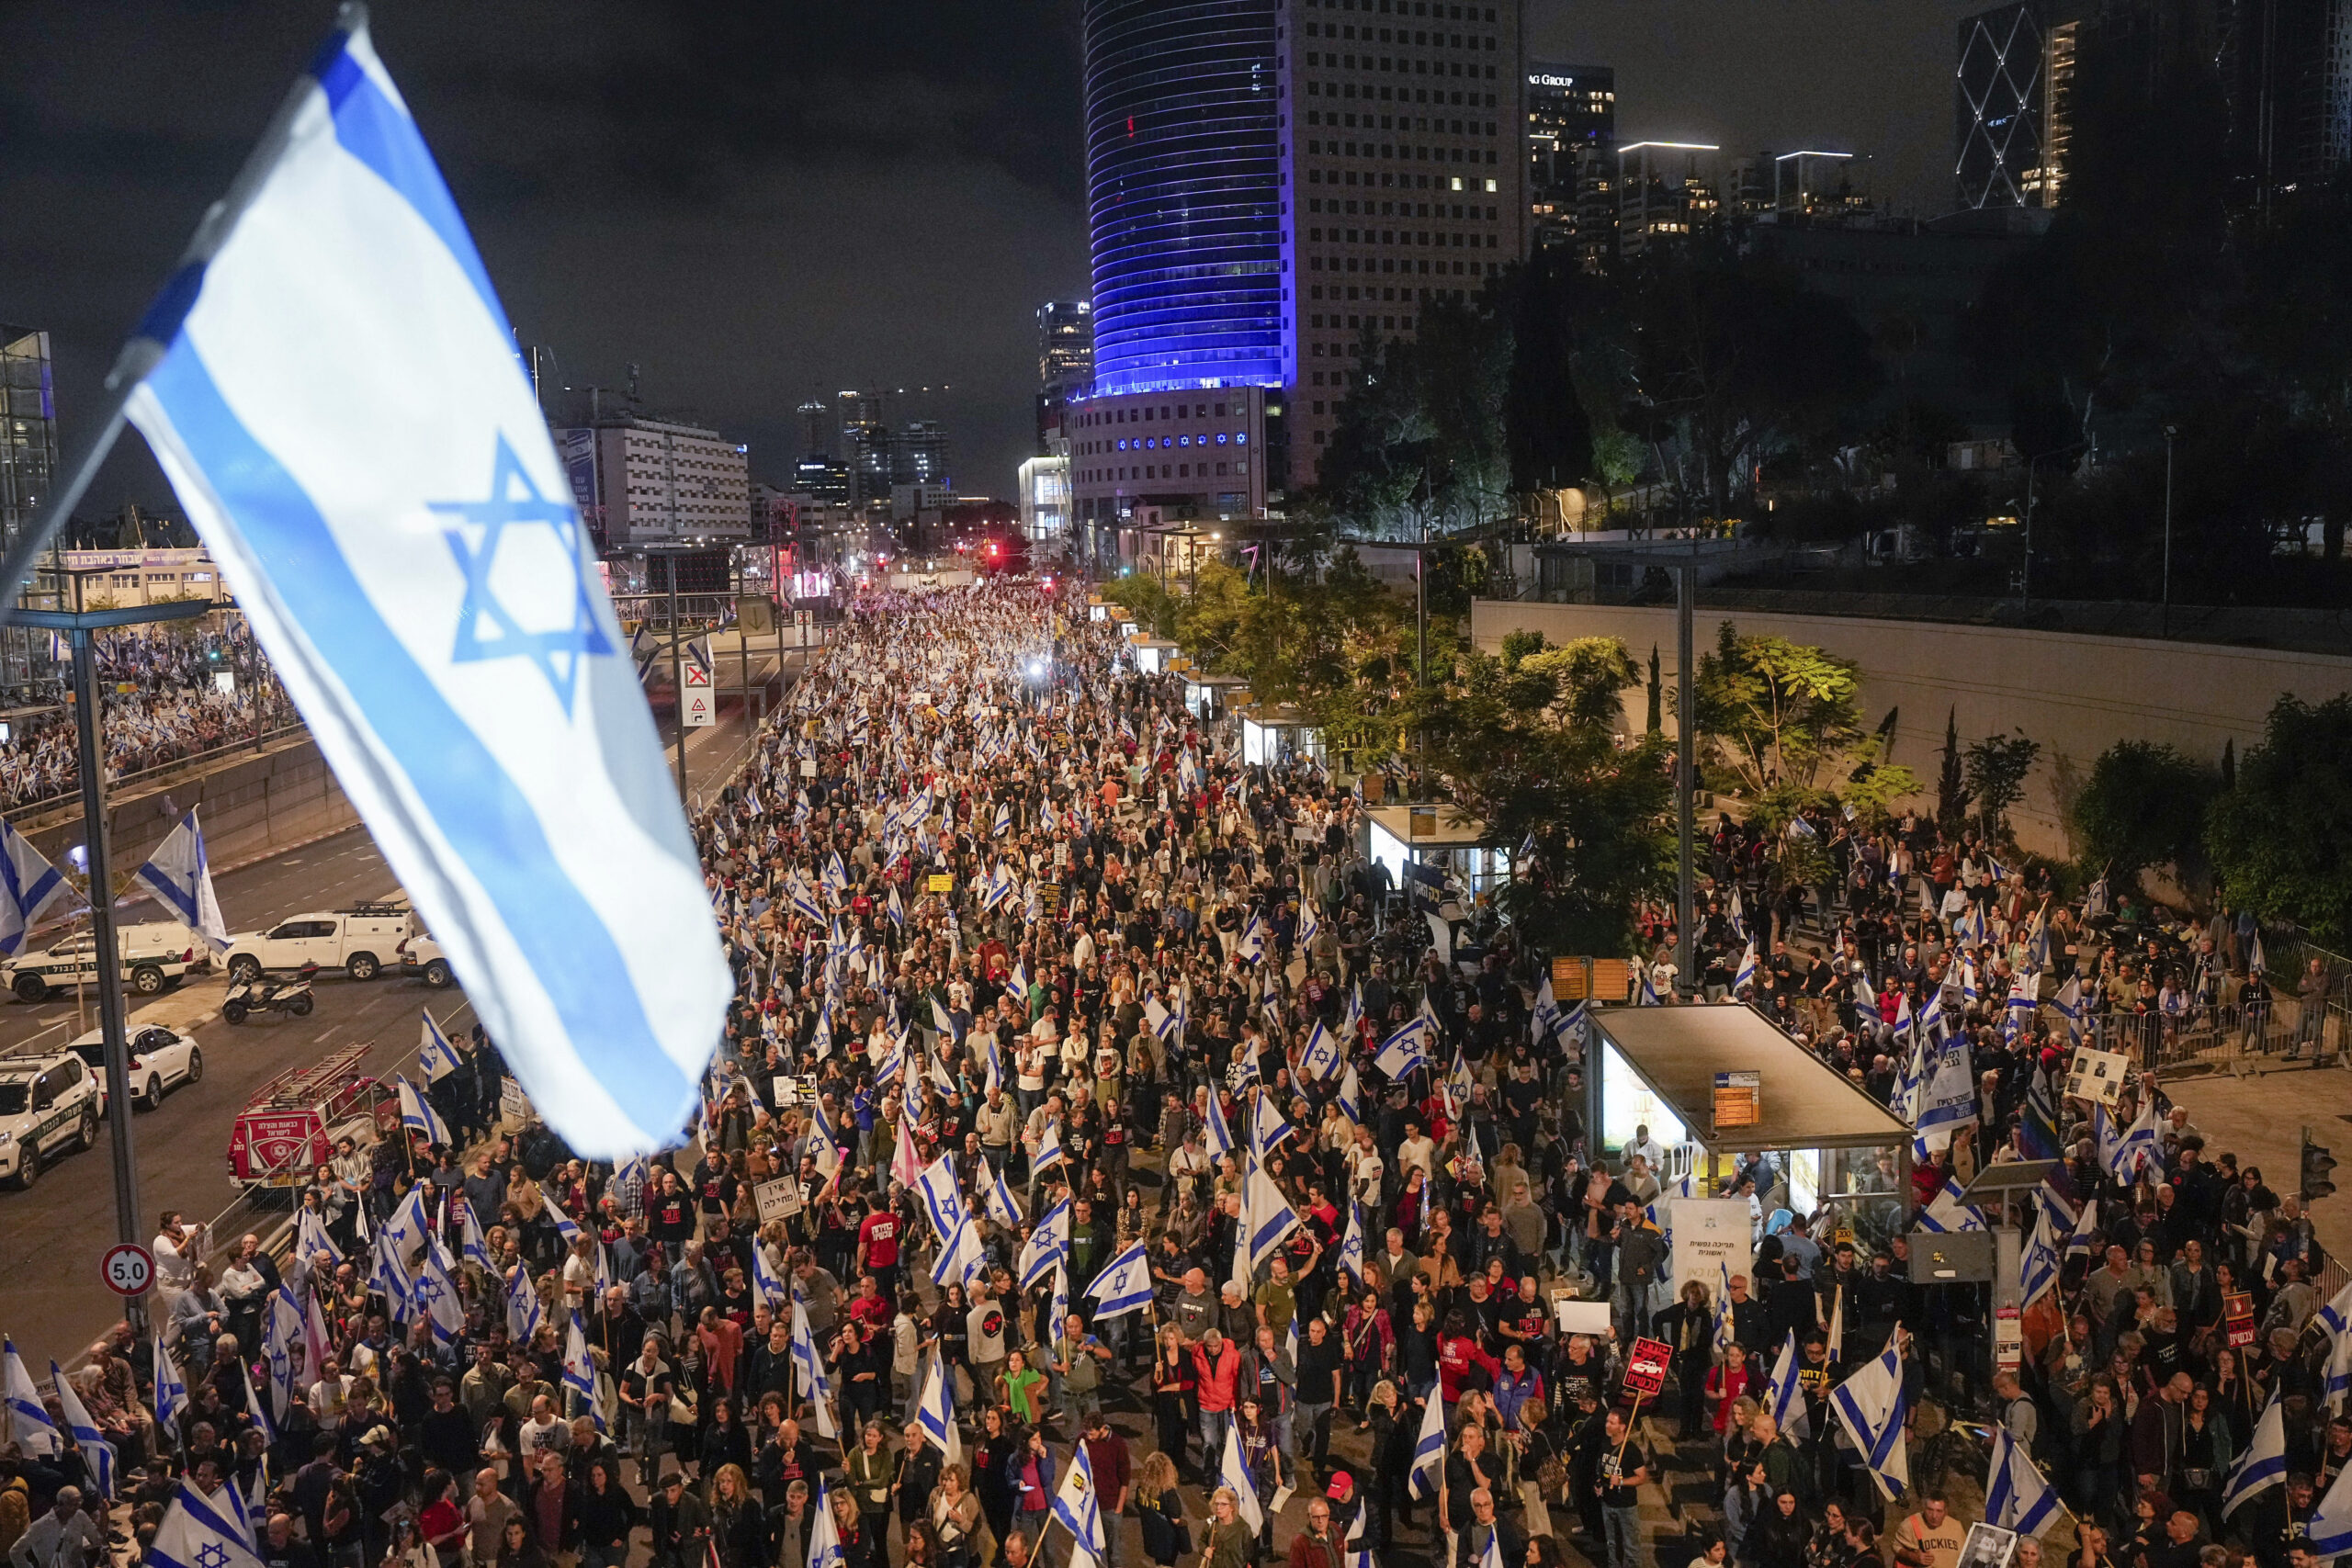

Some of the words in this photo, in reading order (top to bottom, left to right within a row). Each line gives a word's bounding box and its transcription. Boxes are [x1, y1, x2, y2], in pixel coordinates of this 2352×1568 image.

[763, 1193, 794, 1210] מחילה
[113, 1262, 144, 1280] 5.0
[1182, 1303, 1204, 1313] CREATVE
[1924, 1538, 1959, 1551] OCKIES
